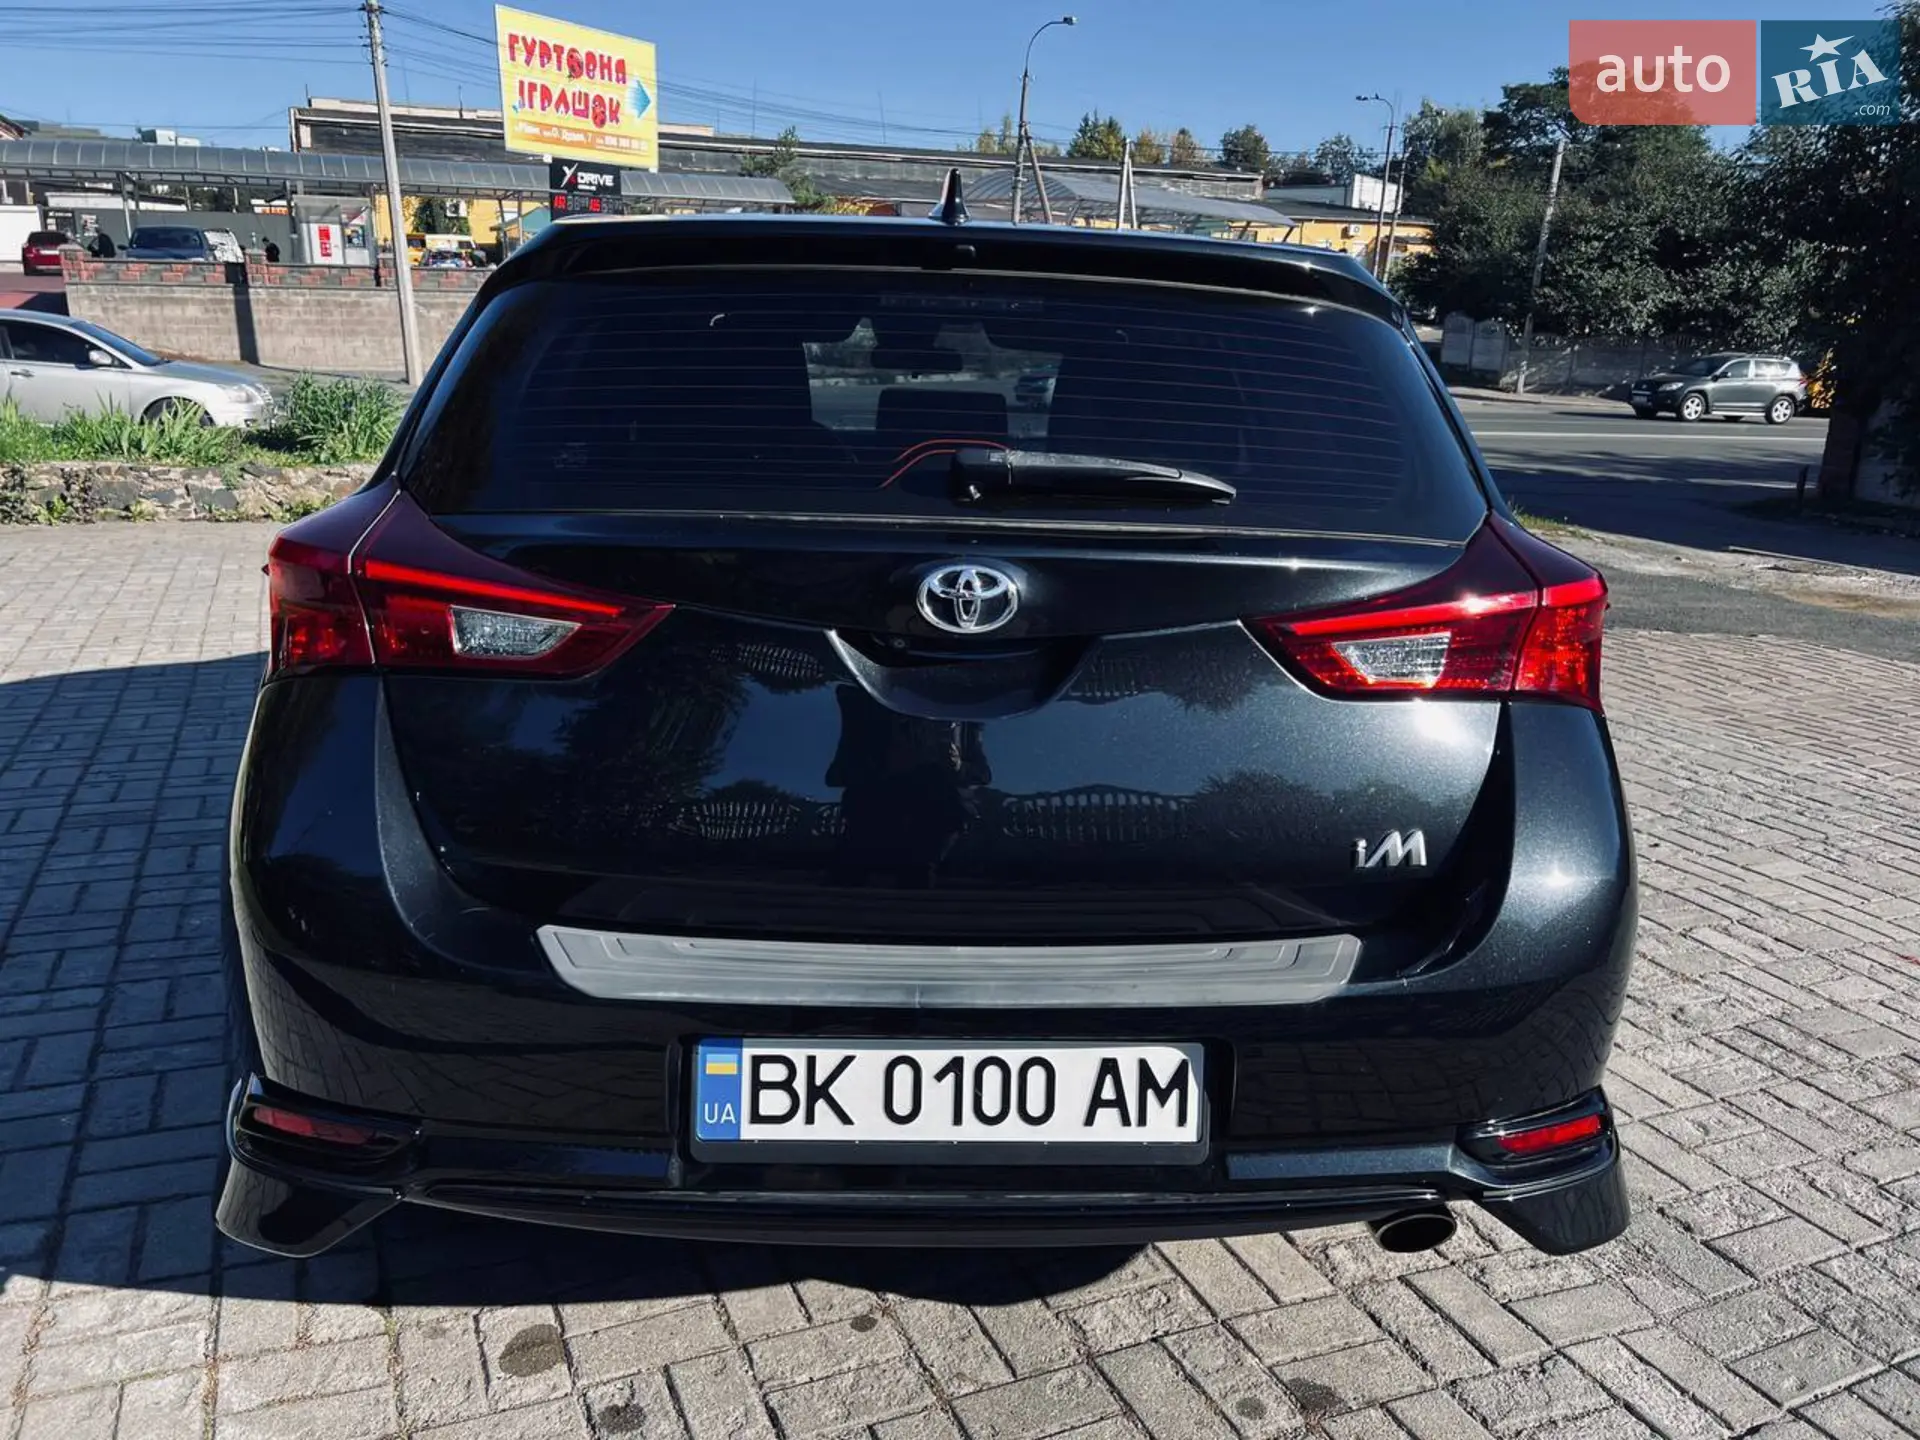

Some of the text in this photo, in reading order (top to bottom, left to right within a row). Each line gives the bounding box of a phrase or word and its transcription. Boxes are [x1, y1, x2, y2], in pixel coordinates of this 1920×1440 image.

[518, 79, 621, 128] ІГРАШОК
[704, 1055, 1190, 1128] UA BK 0100 AM
